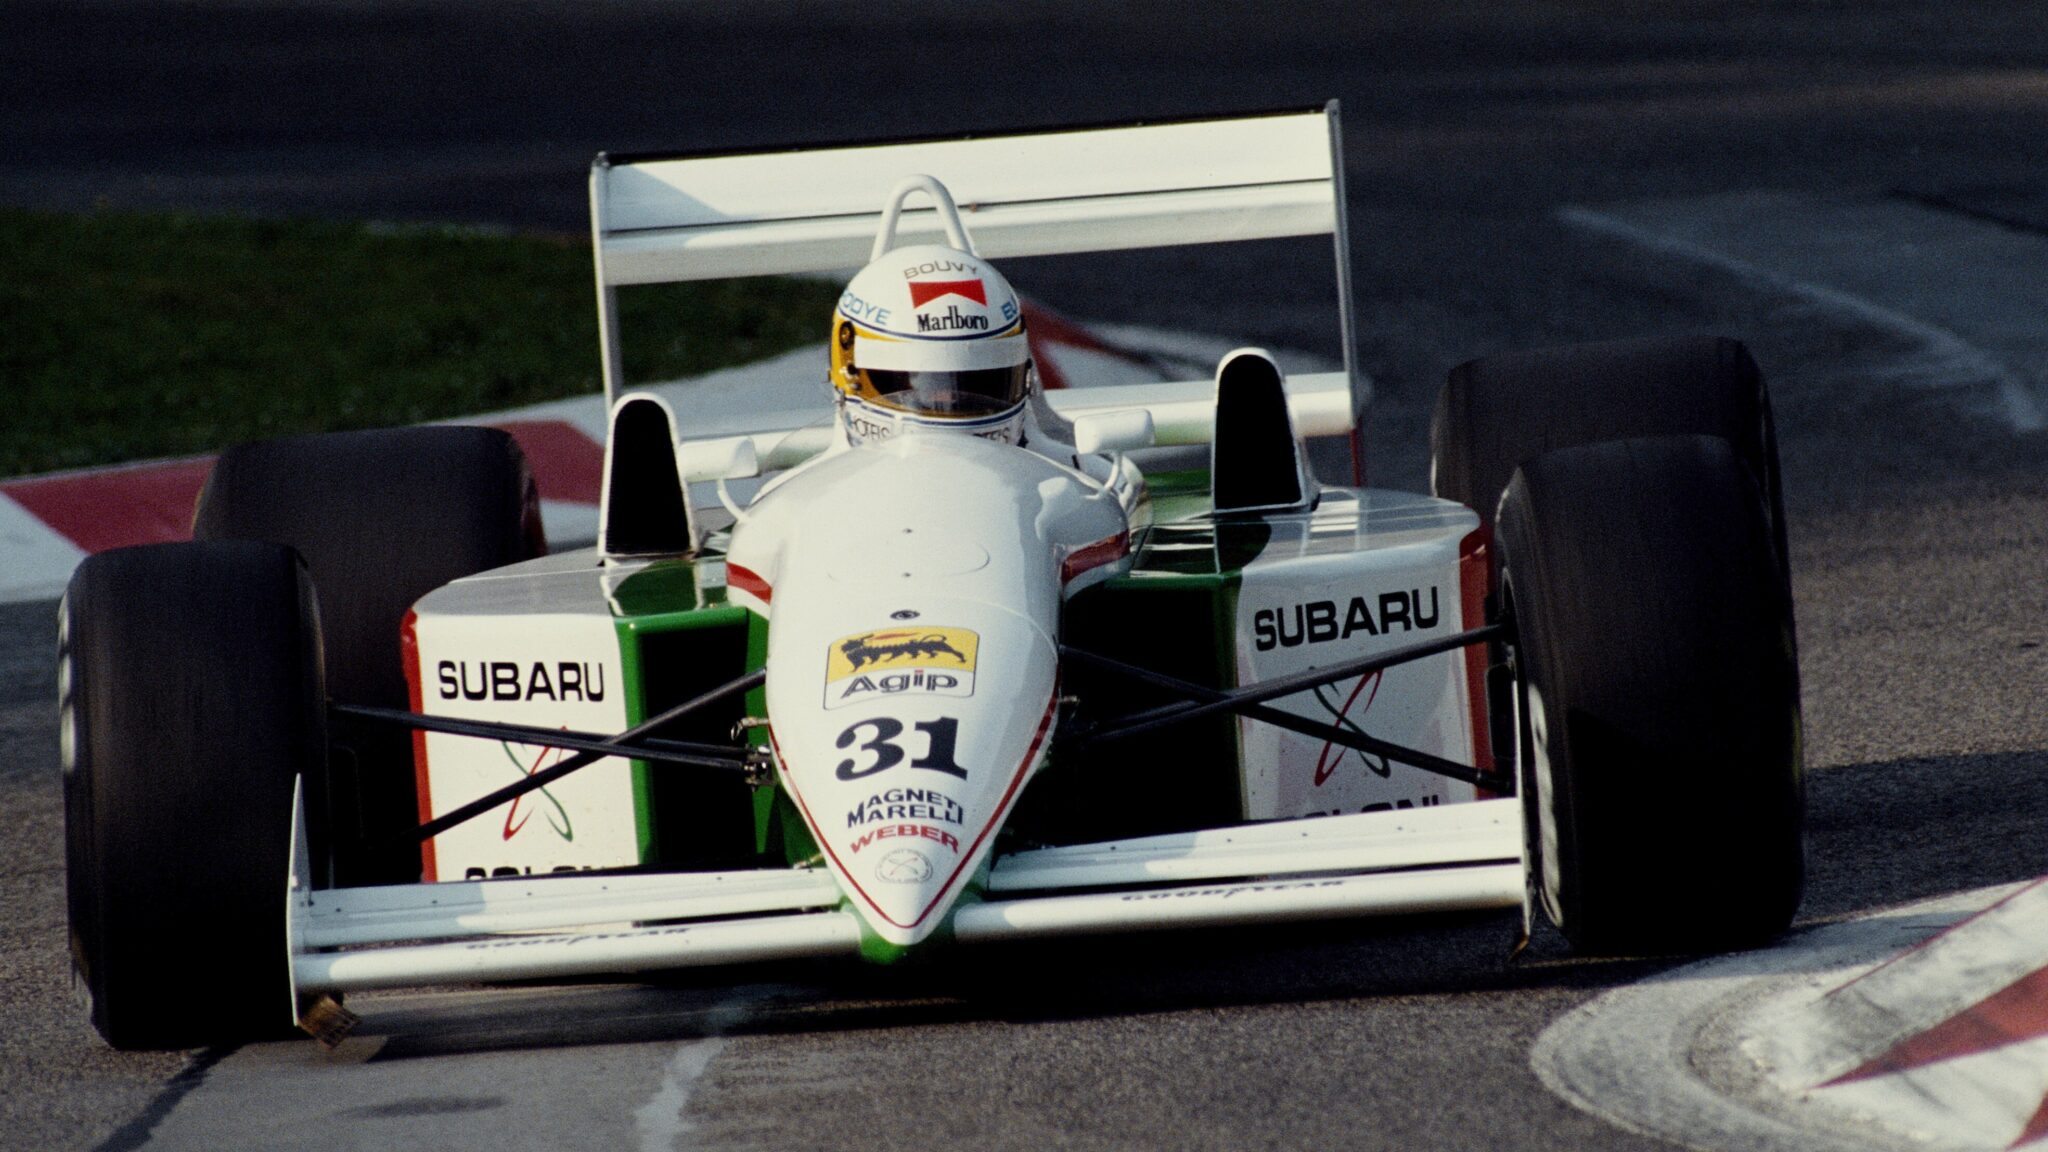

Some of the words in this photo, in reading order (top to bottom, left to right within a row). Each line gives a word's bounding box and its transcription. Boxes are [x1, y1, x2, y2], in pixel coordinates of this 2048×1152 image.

[903, 260, 978, 279] BOUVY
[917, 305, 989, 332] Marlboro
[1254, 586, 1439, 651] SUBARU
[438, 660, 604, 702] SUBARU
[840, 669, 958, 699] Agip
[835, 716, 968, 781] 31
[850, 824, 959, 854] WEBER
